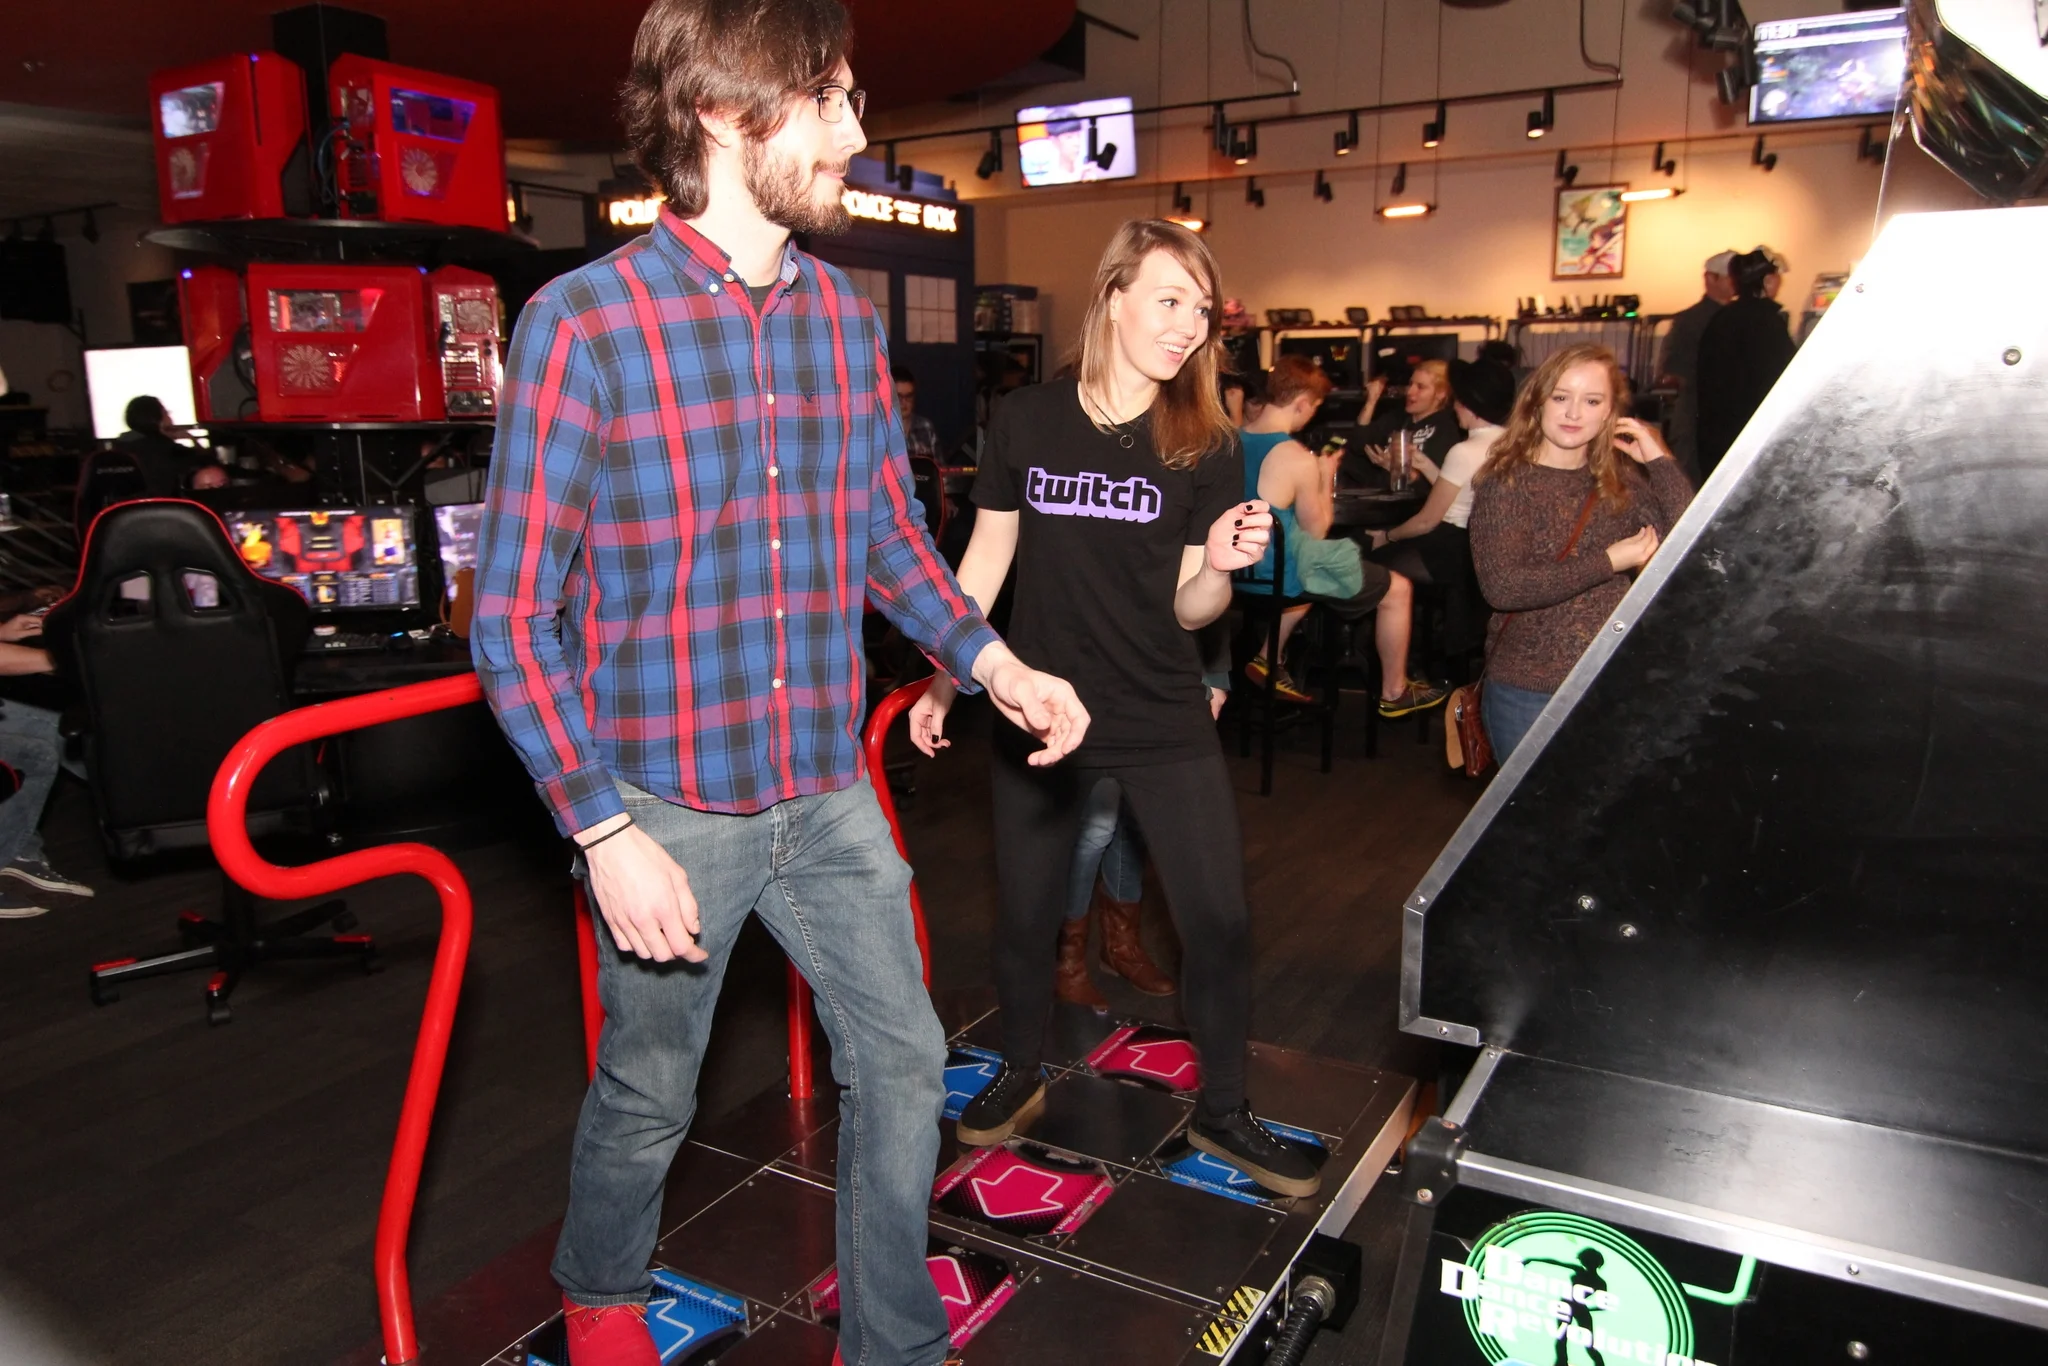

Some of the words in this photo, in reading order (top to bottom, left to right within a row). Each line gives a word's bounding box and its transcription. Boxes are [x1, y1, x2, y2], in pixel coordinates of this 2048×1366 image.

[1027, 468, 1160, 519] twitch
[1440, 1258, 1573, 1322] Dance
[1484, 1243, 1621, 1312] Dance
